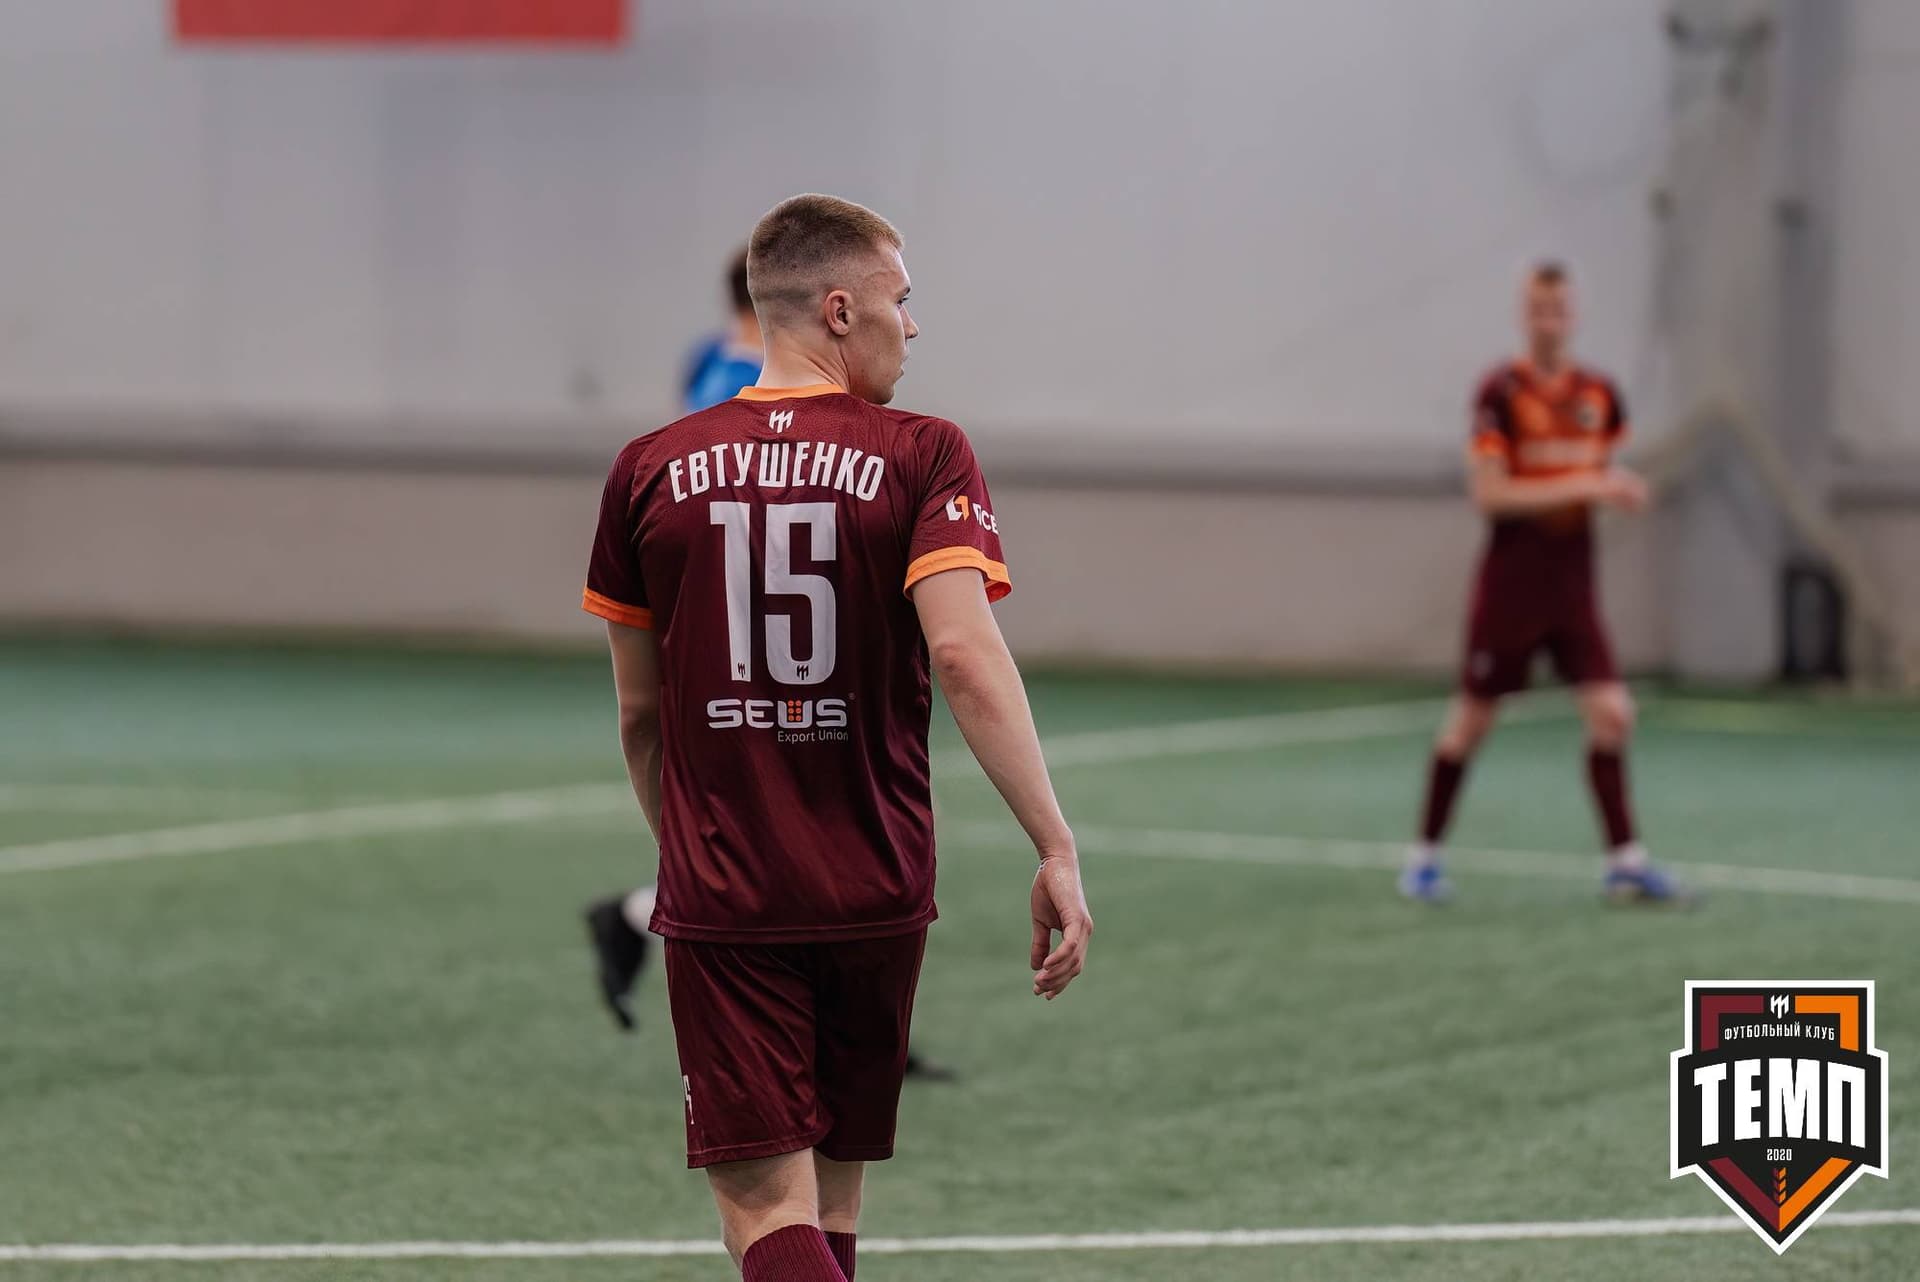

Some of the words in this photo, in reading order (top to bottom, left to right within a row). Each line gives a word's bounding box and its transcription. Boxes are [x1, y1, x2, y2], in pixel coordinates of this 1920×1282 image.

[668, 441, 884, 503] ЕВТУШЕНКО
[709, 501, 837, 685] 15
[707, 698, 848, 729] SEUS
[777, 730, 816, 745] Export
[818, 730, 849, 742] Union
